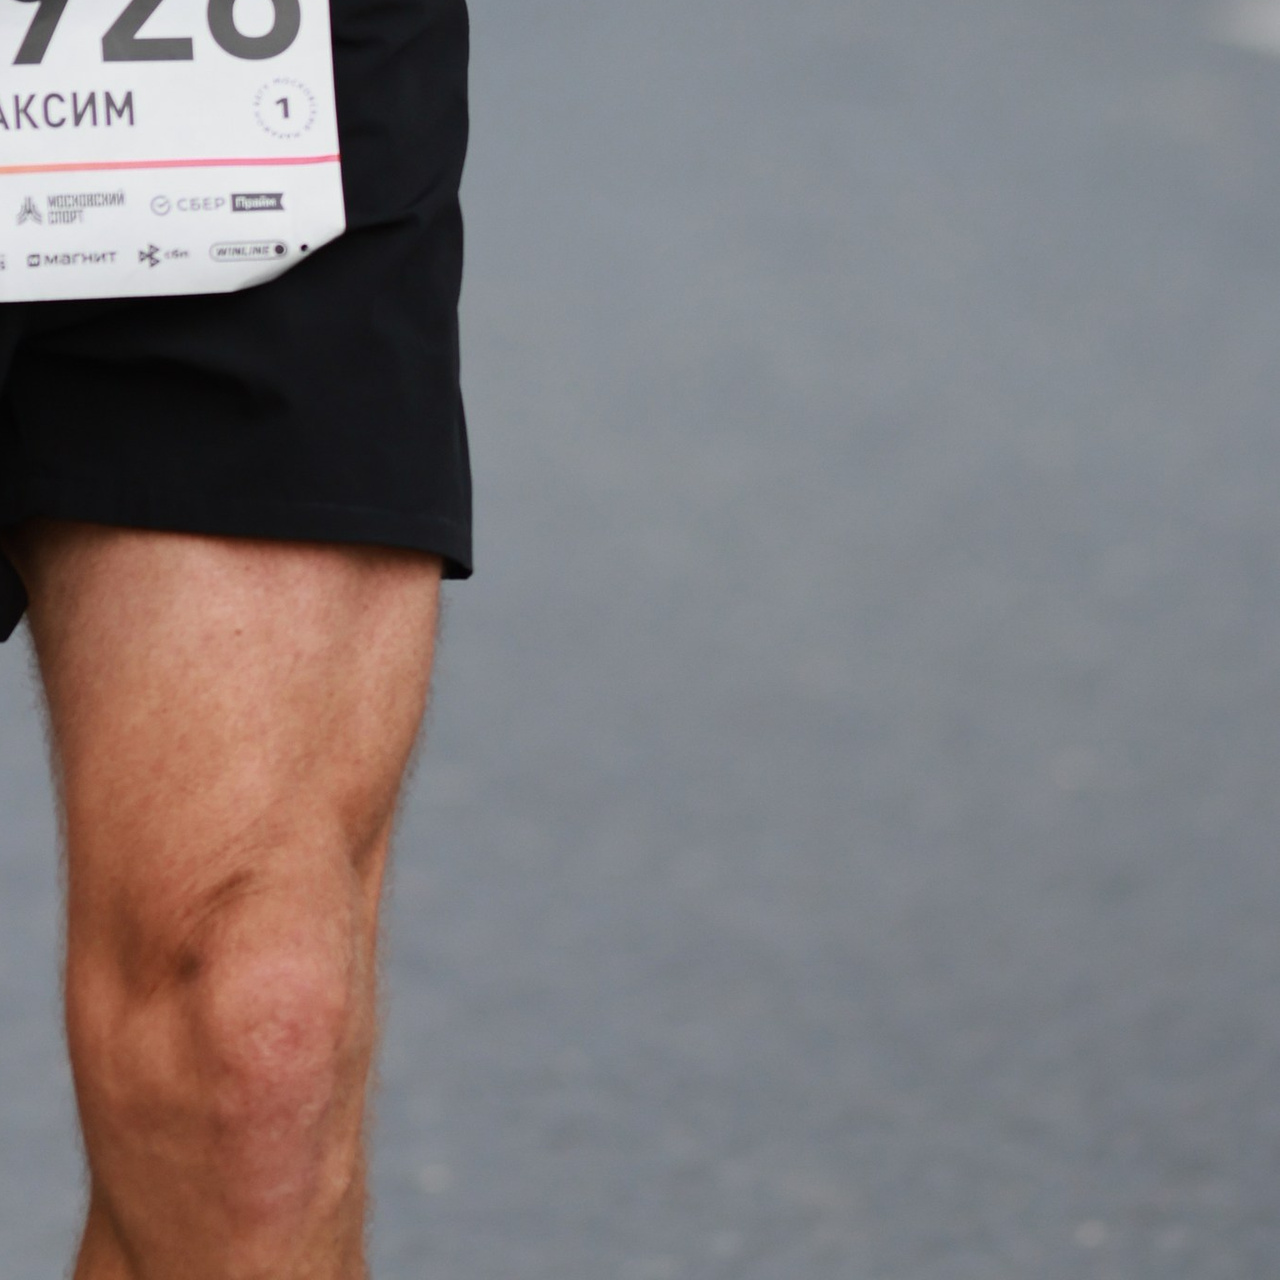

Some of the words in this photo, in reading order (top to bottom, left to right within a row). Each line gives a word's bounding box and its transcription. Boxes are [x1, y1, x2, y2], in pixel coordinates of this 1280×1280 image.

[275, 97, 289, 119] 1
[47, 188, 125, 208] МОСКОВСКИЙ
[176, 197, 226, 212] СБЕР
[48, 210, 84, 225] СПОРТ
